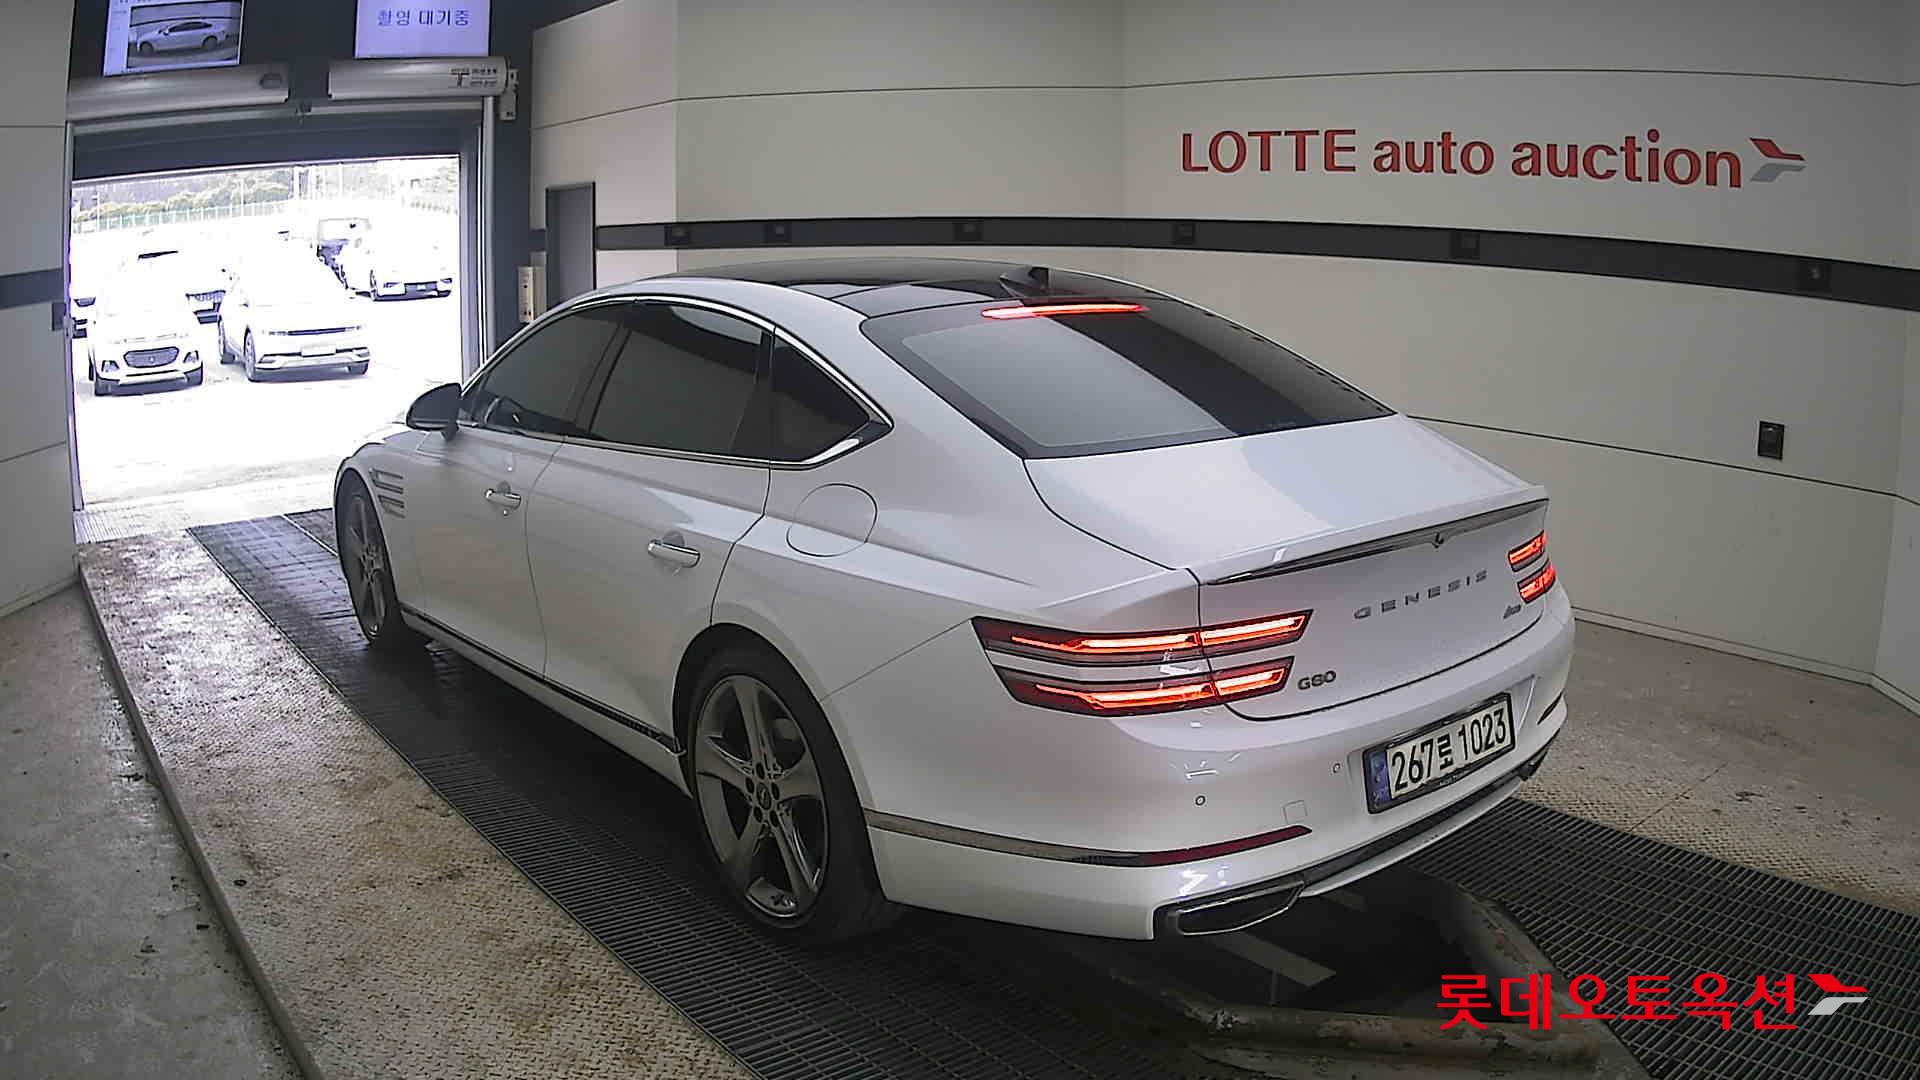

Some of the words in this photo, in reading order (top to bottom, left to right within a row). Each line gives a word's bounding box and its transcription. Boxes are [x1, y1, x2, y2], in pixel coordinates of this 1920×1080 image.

[419, 9, 469, 26] 대기중
[1181, 129, 1357, 173] LOTTE
[1372, 131, 1494, 175] auto
[1510, 128, 1742, 188] auction
[1353, 570, 1487, 619] GENESIS
[1297, 670, 1337, 690] G80
[1458, 708, 1506, 761] 1023
